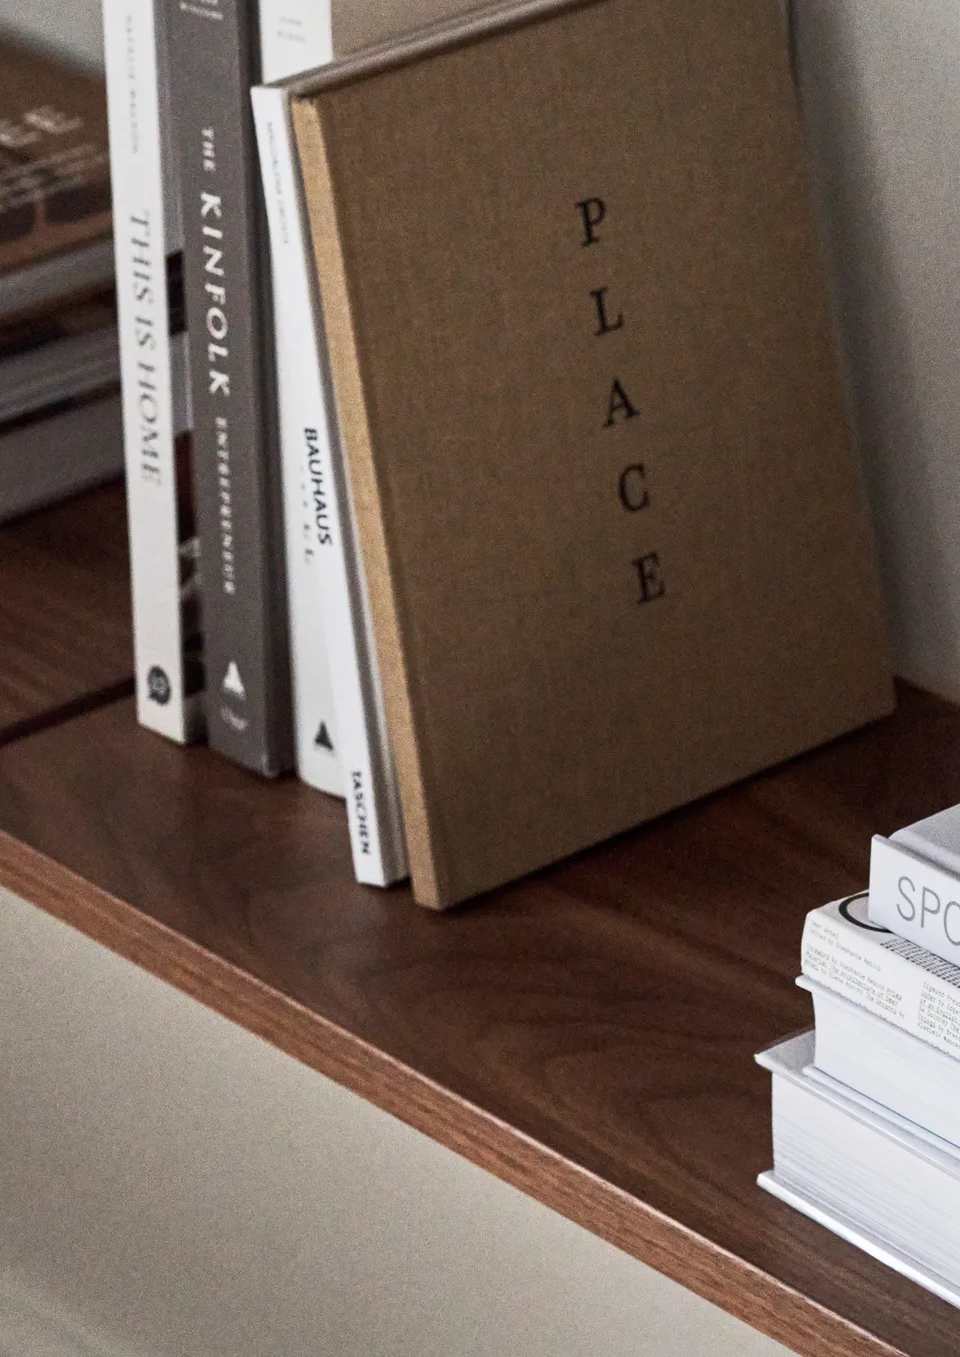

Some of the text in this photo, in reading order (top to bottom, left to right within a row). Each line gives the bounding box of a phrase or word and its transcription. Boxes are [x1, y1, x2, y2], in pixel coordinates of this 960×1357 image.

[202, 127, 216, 172] THE
[130, 209, 161, 486] THIS IS HOME
[200, 191, 231, 397] KINFOLK
[574, 196, 667, 605] PLACE
[304, 427, 334, 546] BAUHAUS
[351, 770, 371, 855] TASCHEN
